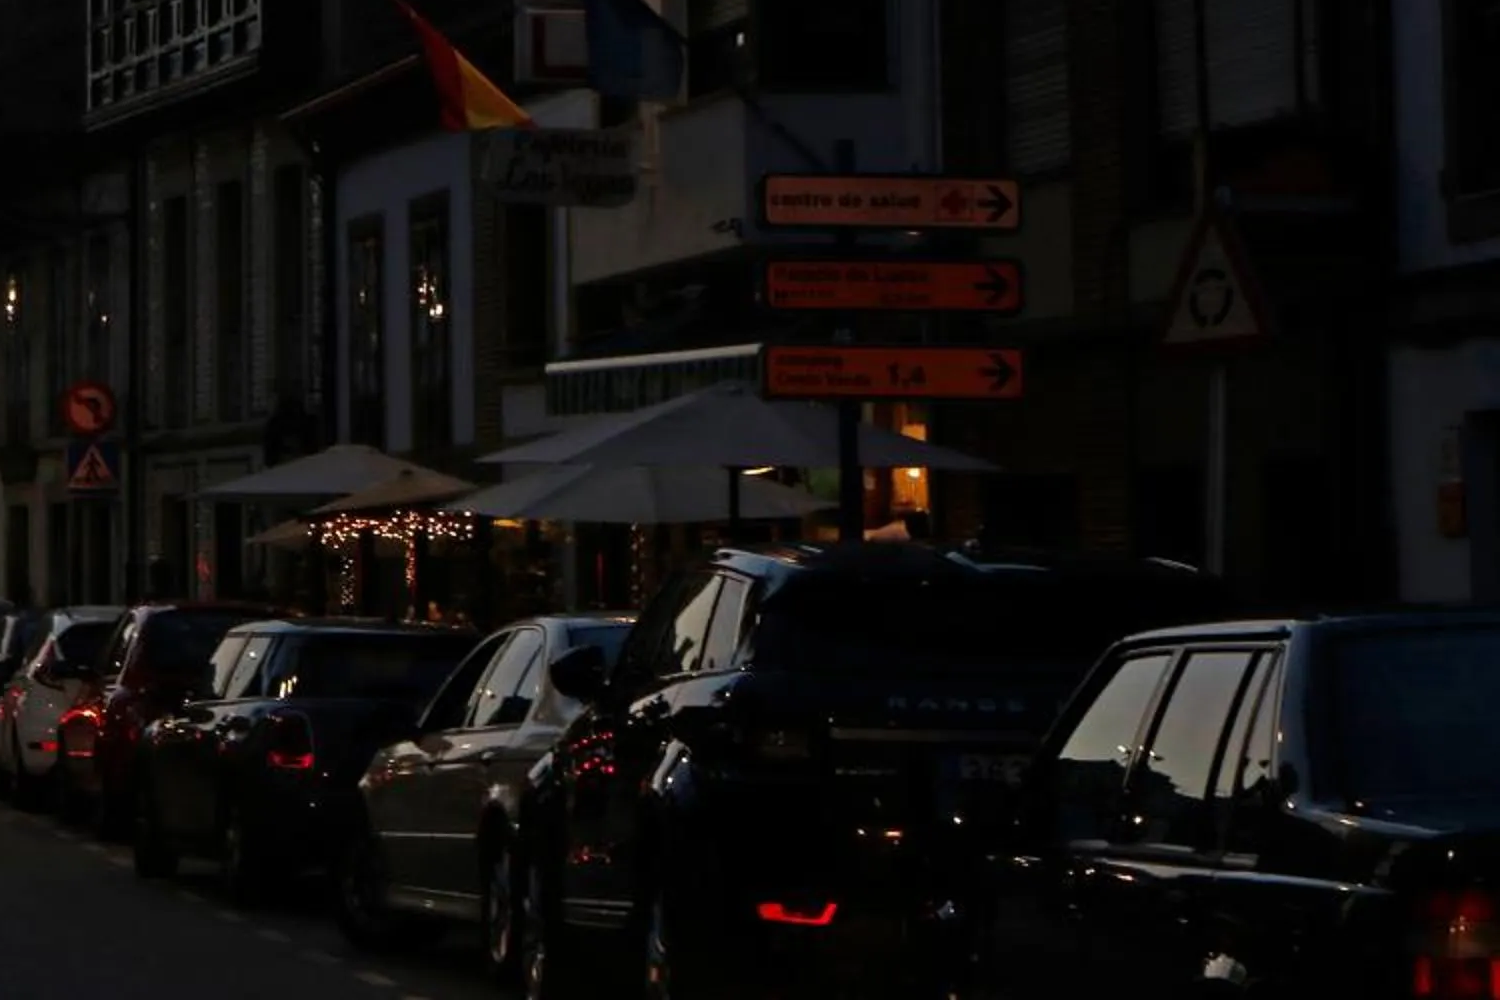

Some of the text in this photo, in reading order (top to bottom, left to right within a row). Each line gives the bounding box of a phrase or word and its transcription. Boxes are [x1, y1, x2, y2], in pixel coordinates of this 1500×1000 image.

[771, 192, 921, 209] centro de salud
[887, 696, 1026, 713] RANGE
